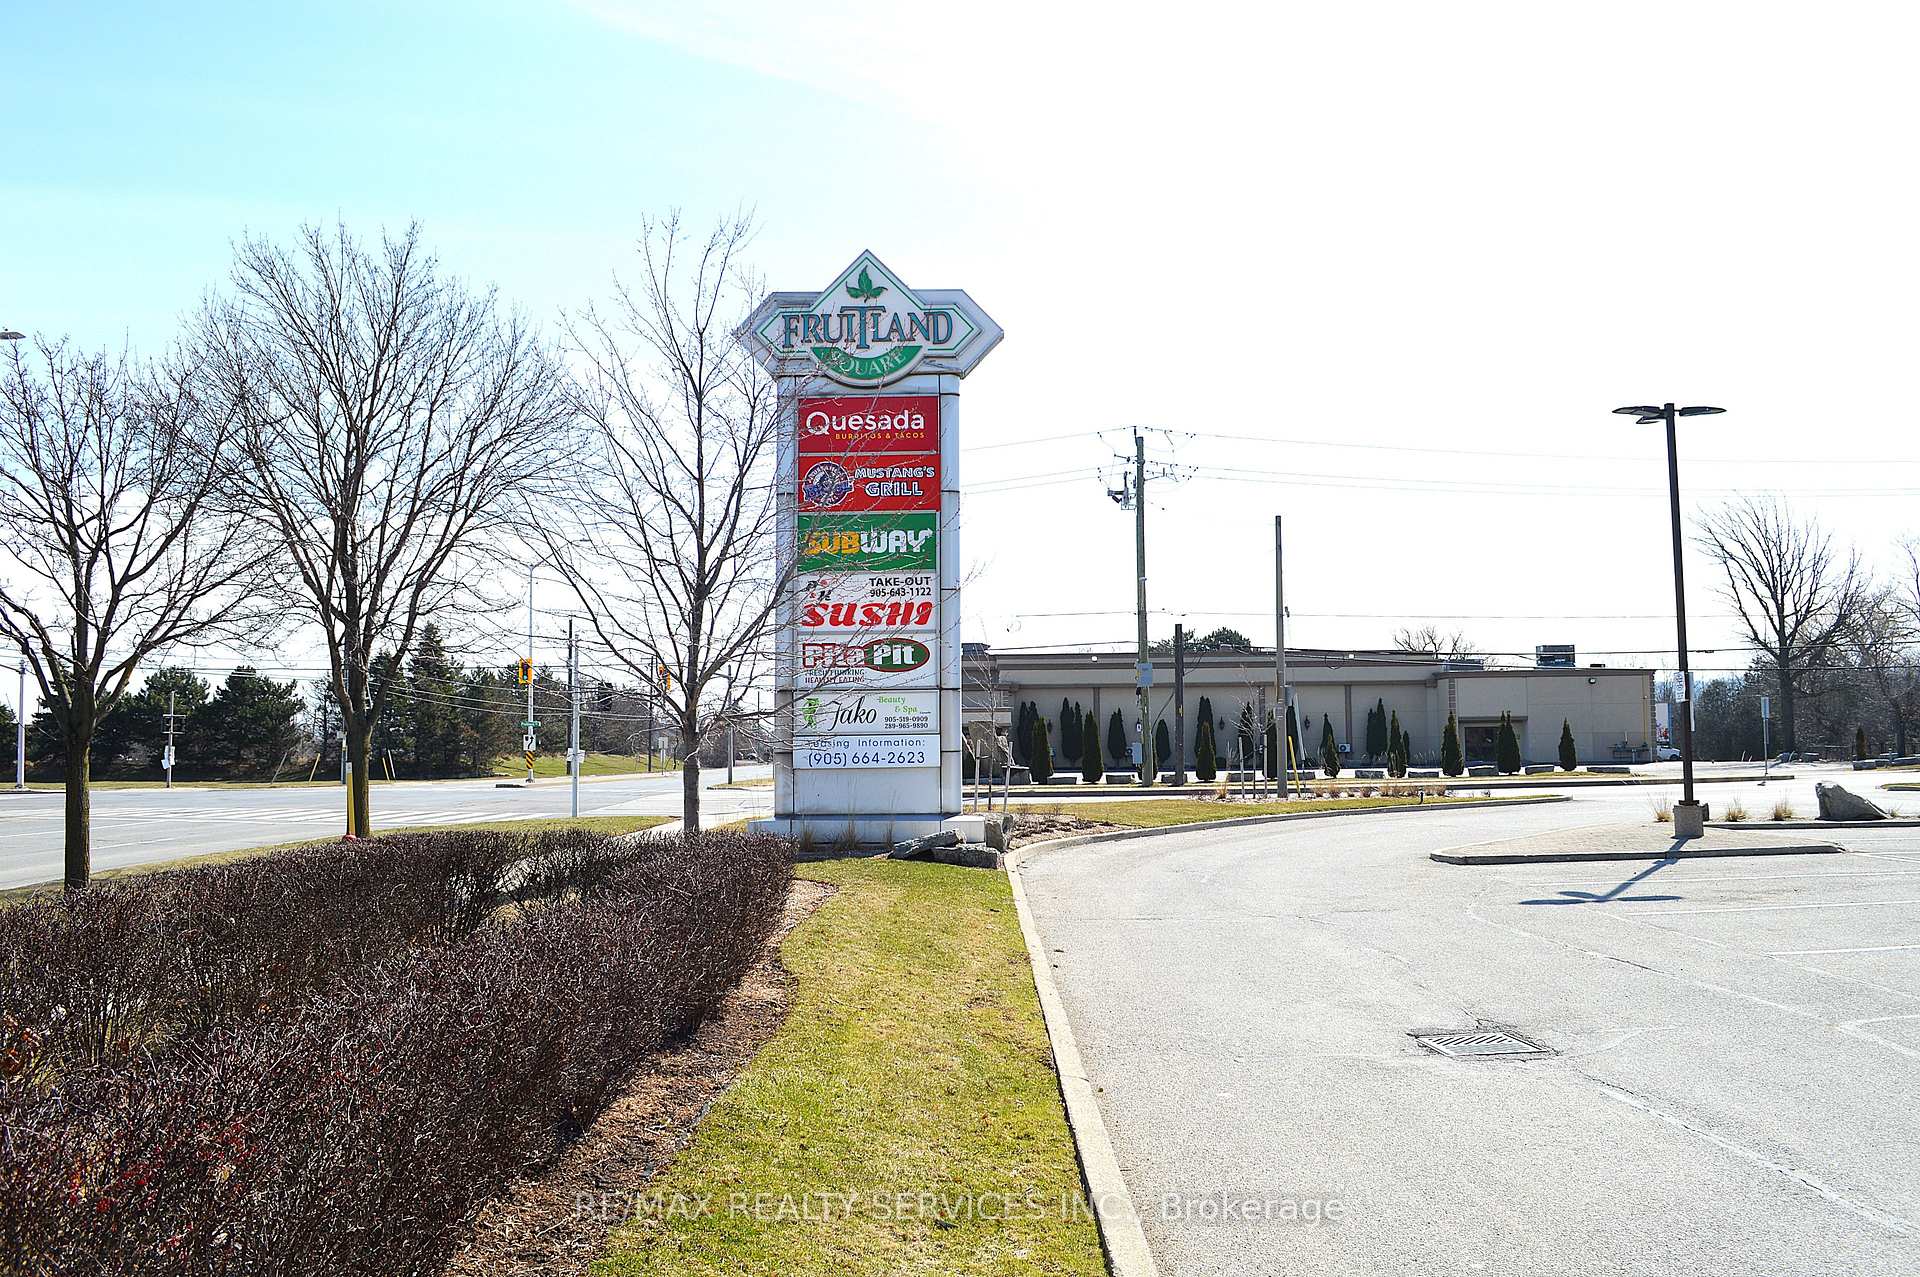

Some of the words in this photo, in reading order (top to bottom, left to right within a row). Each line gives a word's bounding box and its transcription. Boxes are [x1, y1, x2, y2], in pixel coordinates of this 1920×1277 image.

[782, 305, 954, 350] FRUITLAND
[825, 350, 907, 376] QUARE
[805, 409, 925, 435] Quesada
[835, 432, 882, 440] BURRITOS
[895, 431, 925, 439] TACOS
[854, 466, 935, 479] MUSTANG'S
[864, 481, 924, 497] GRILL
[805, 528, 934, 555] SUBWAY
[869, 576, 932, 587] TAKE-OUT
[869, 586, 932, 598] 905-643-1122
[873, 644, 917, 665] Pit
[878, 696, 906, 705] Beauty
[827, 696, 877, 731] Jako
[902, 705, 918, 715] Spa
[807, 738, 850, 749] easing
[857, 738, 925, 748] Information:
[808, 752, 847, 768] (905)
[851, 751, 926, 764] 664-2623
